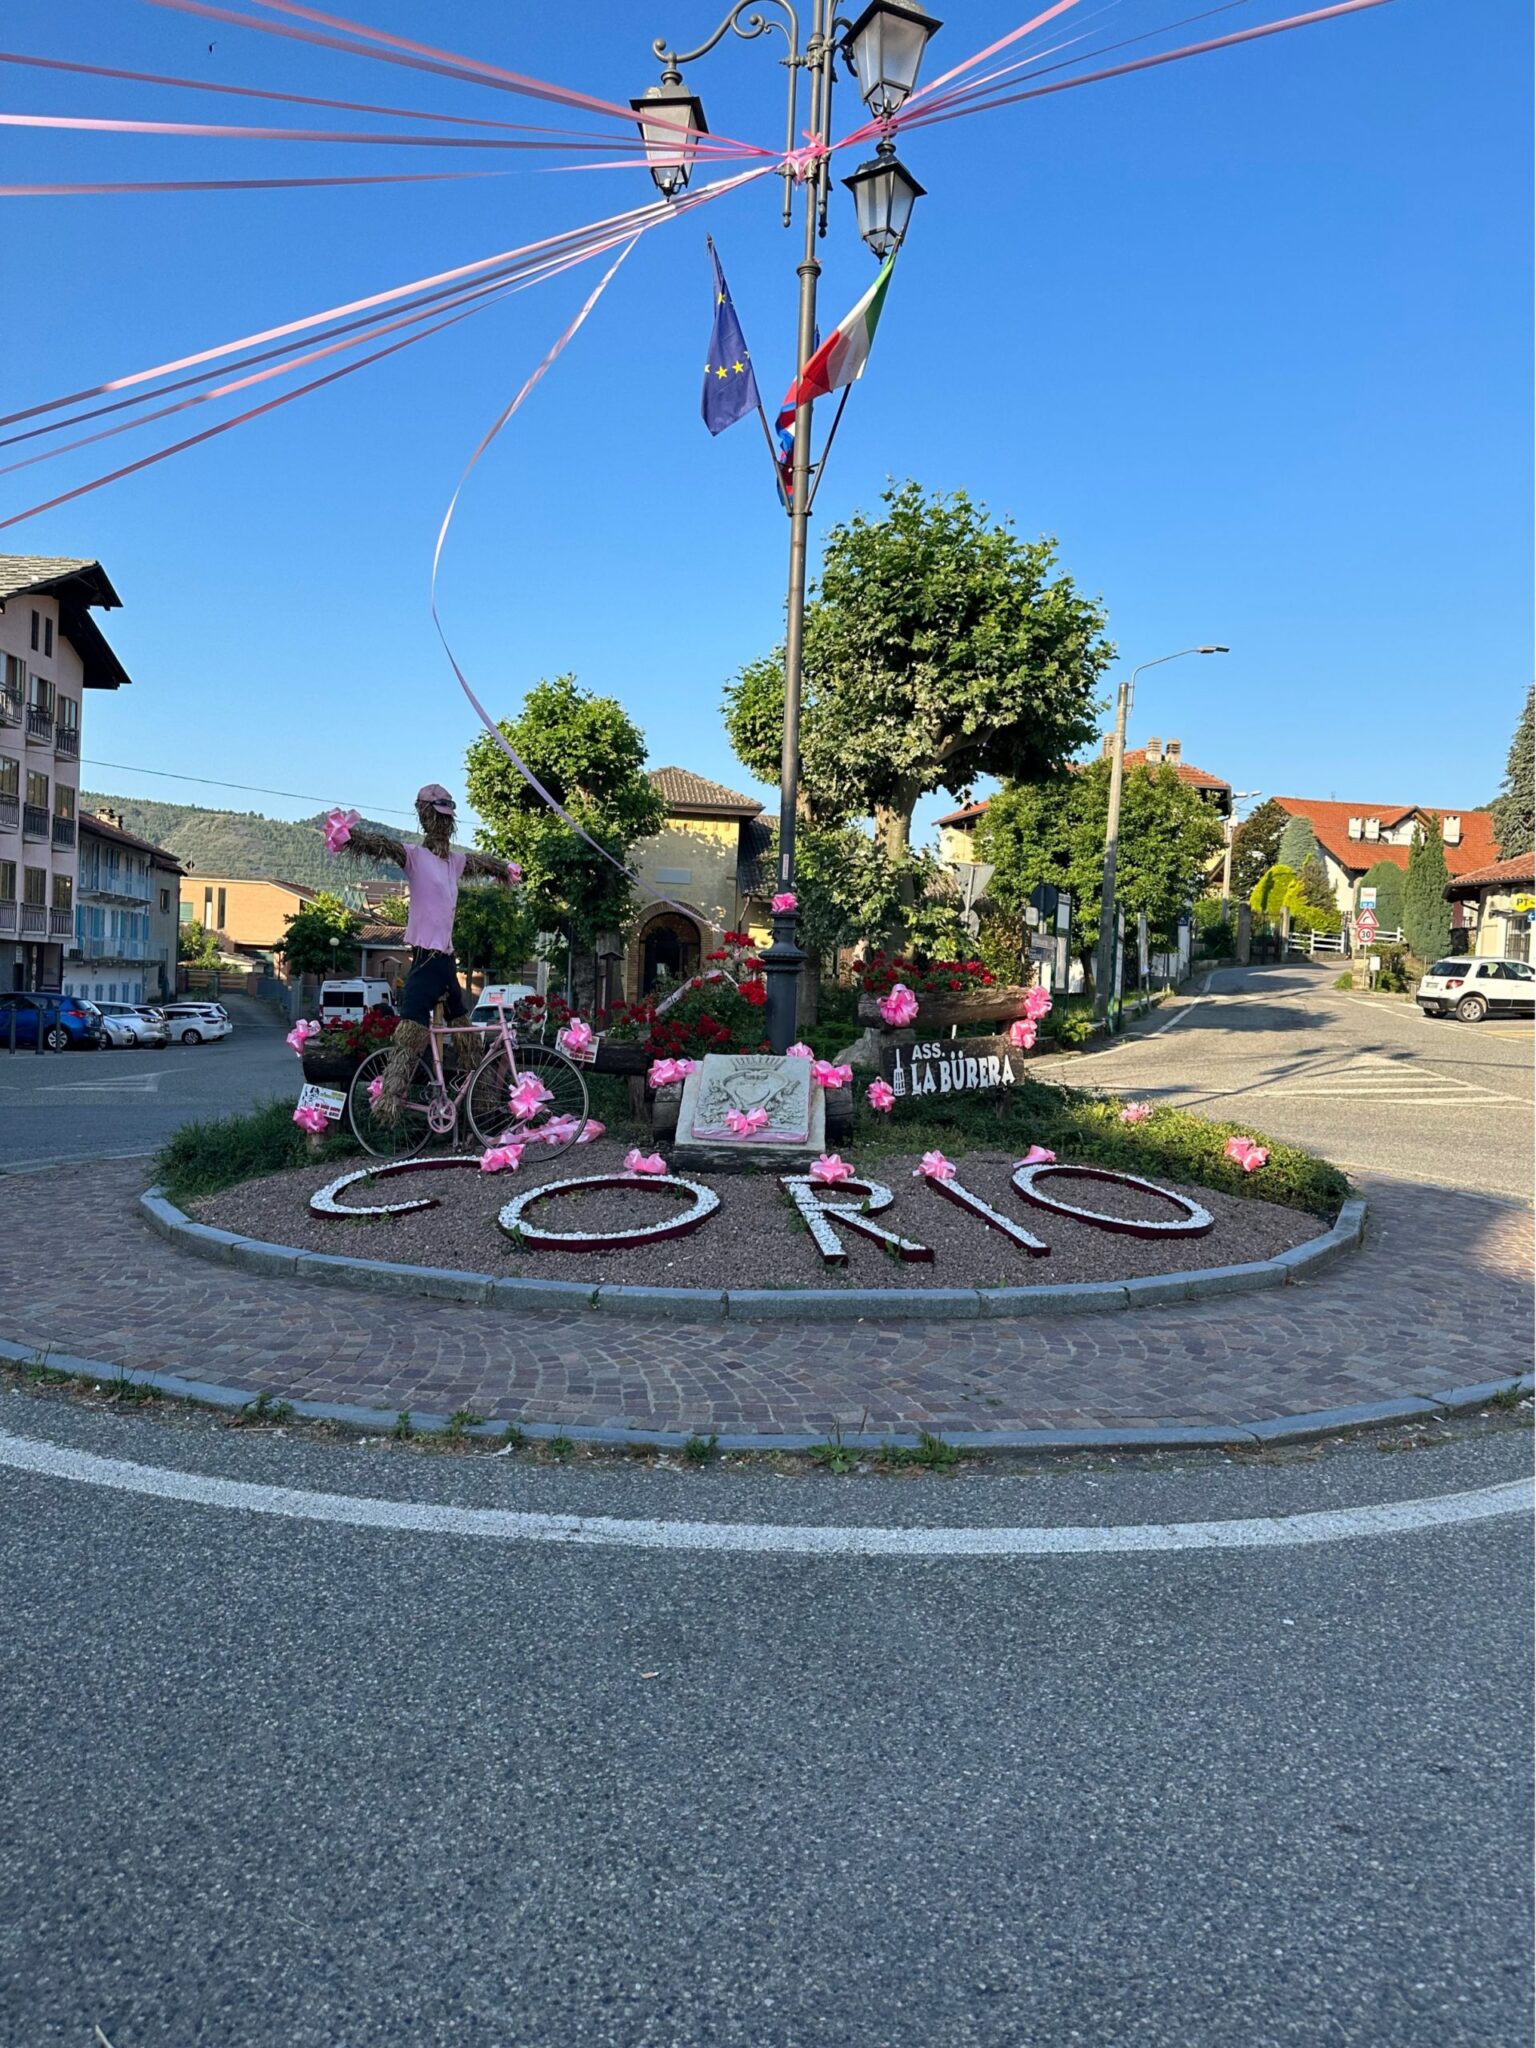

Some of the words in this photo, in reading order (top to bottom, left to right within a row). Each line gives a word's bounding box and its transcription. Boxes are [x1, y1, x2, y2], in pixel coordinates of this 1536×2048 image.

[910, 1062, 937, 1096] LA
[939, 1050, 1016, 1094] BÜRERA
[911, 1042, 946, 1060] ASS.
[309, 1154, 1215, 1264] CORIO
